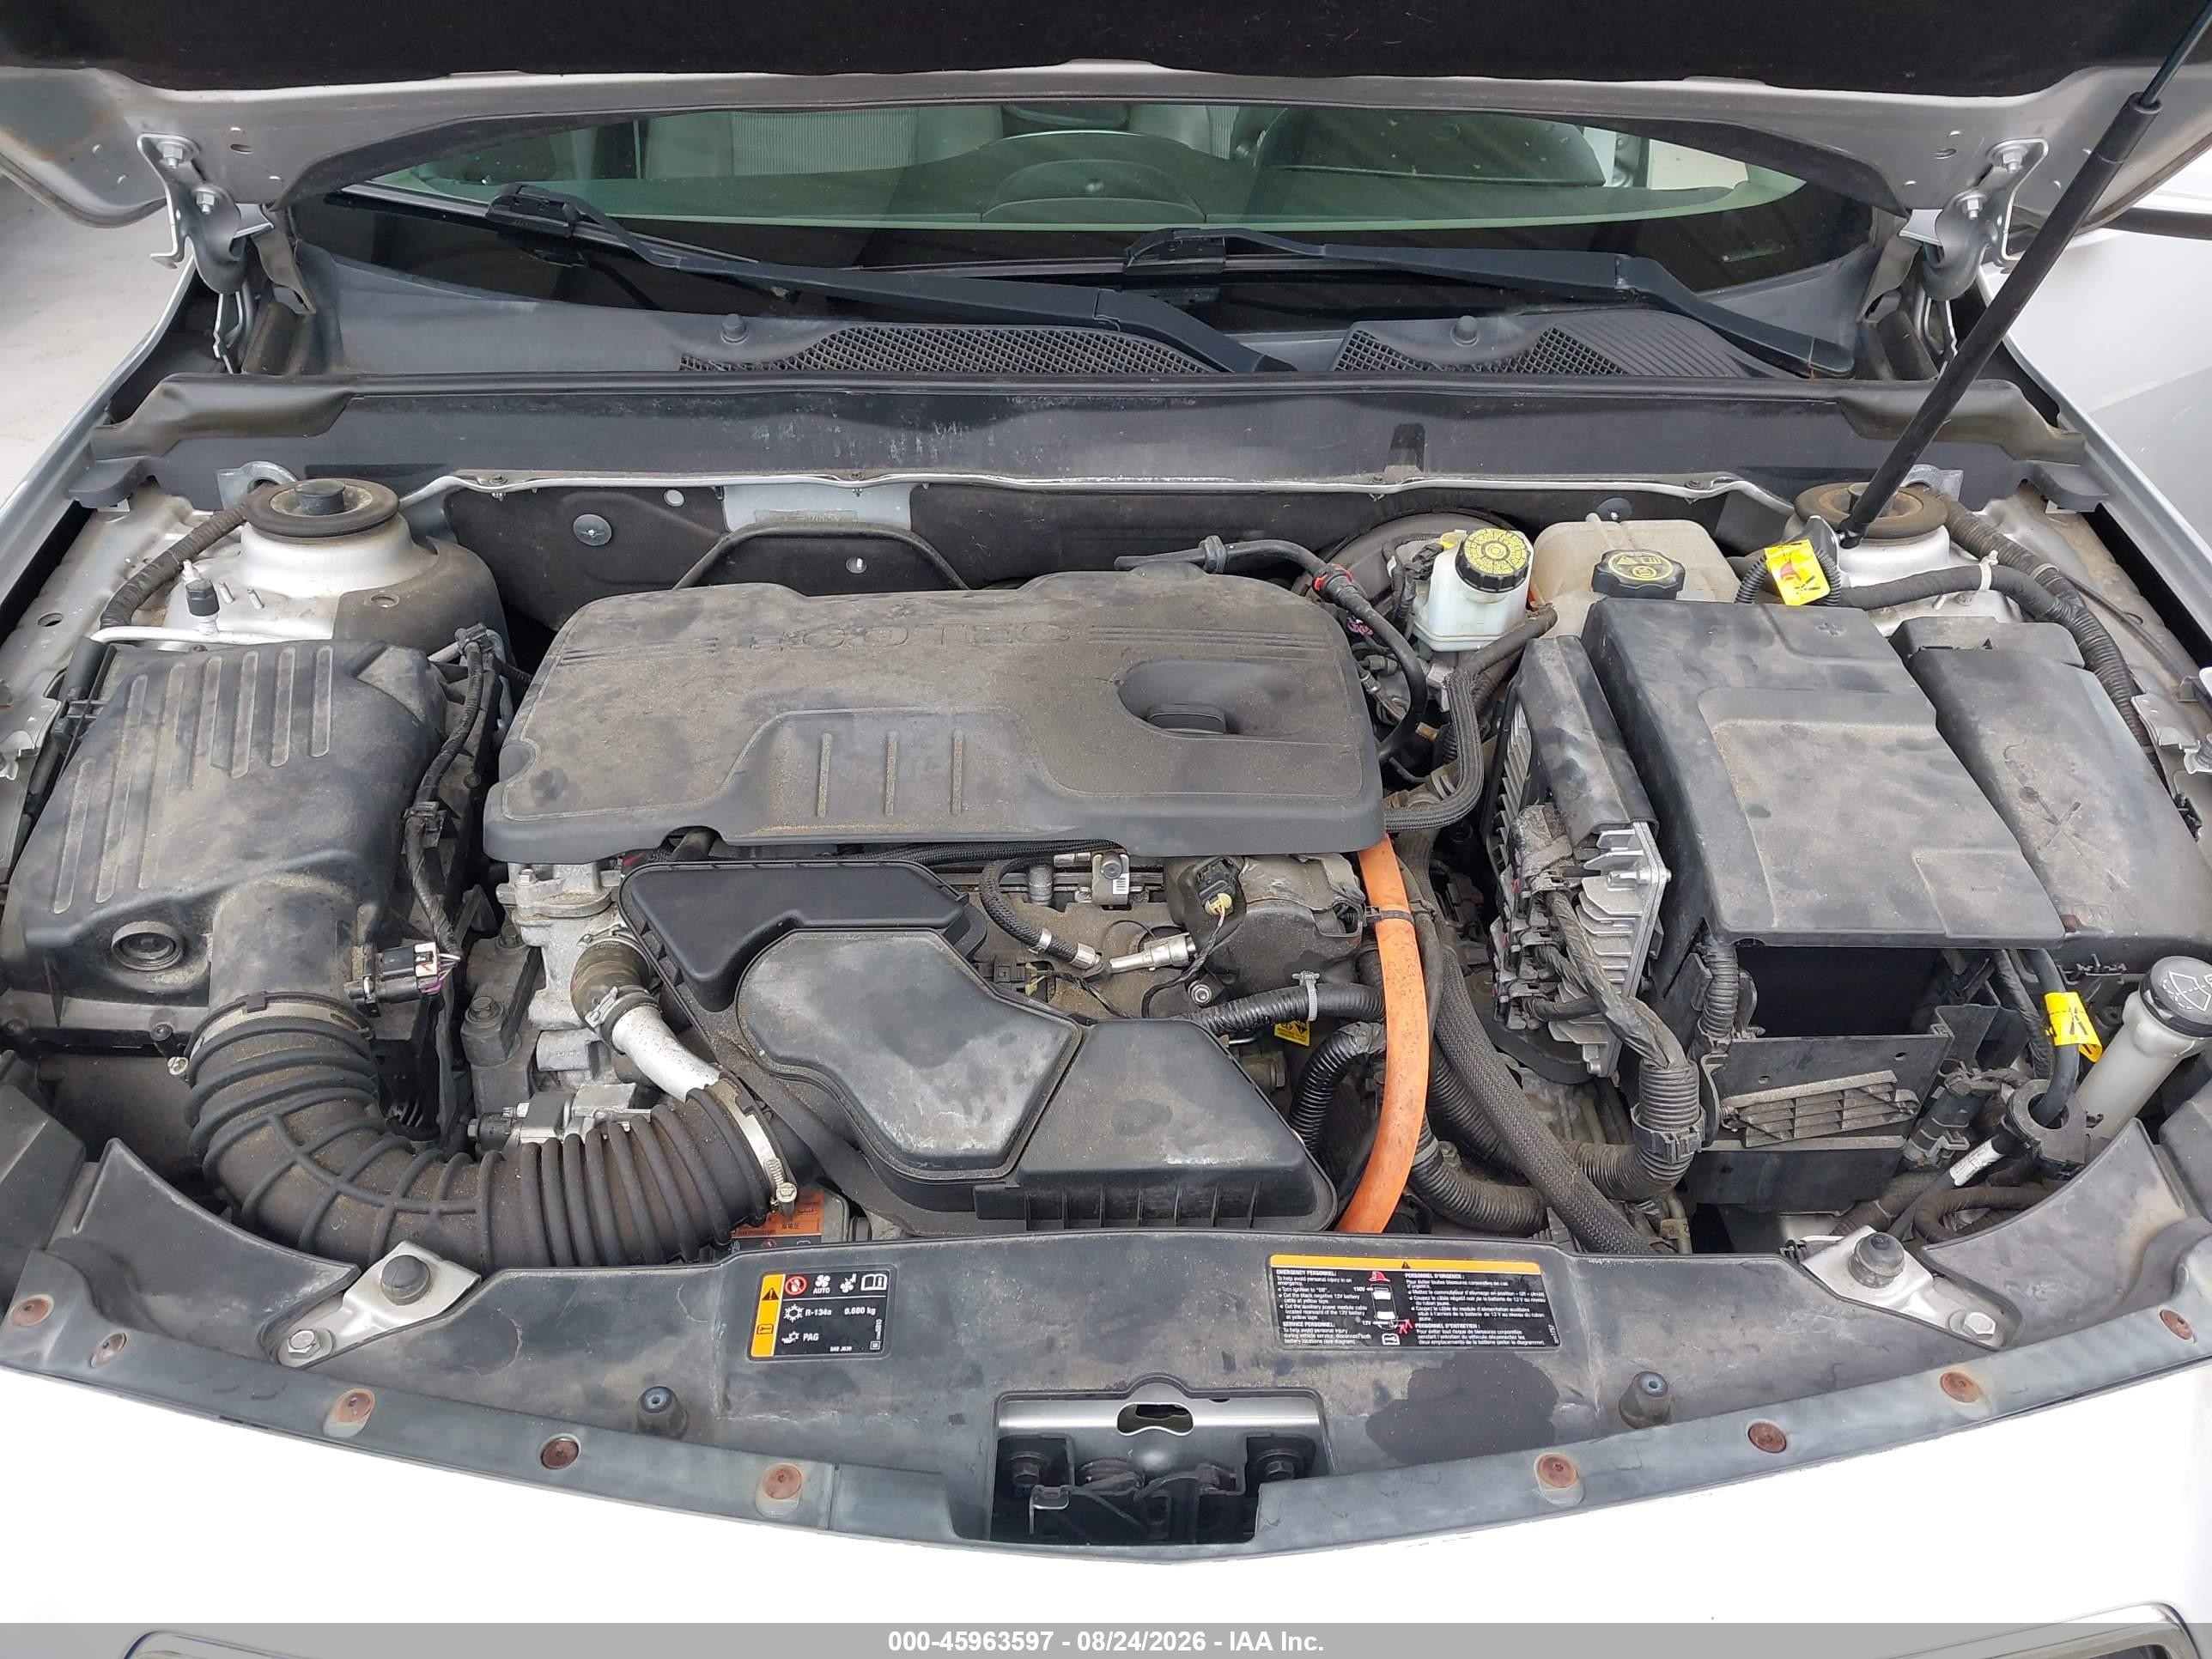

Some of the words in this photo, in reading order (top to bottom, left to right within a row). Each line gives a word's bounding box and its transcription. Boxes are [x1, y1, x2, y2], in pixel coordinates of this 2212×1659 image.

[805, 1308, 832, 1316] R-134a
[866, 1306, 876, 1316] kg
[802, 1333, 819, 1342] PAG
